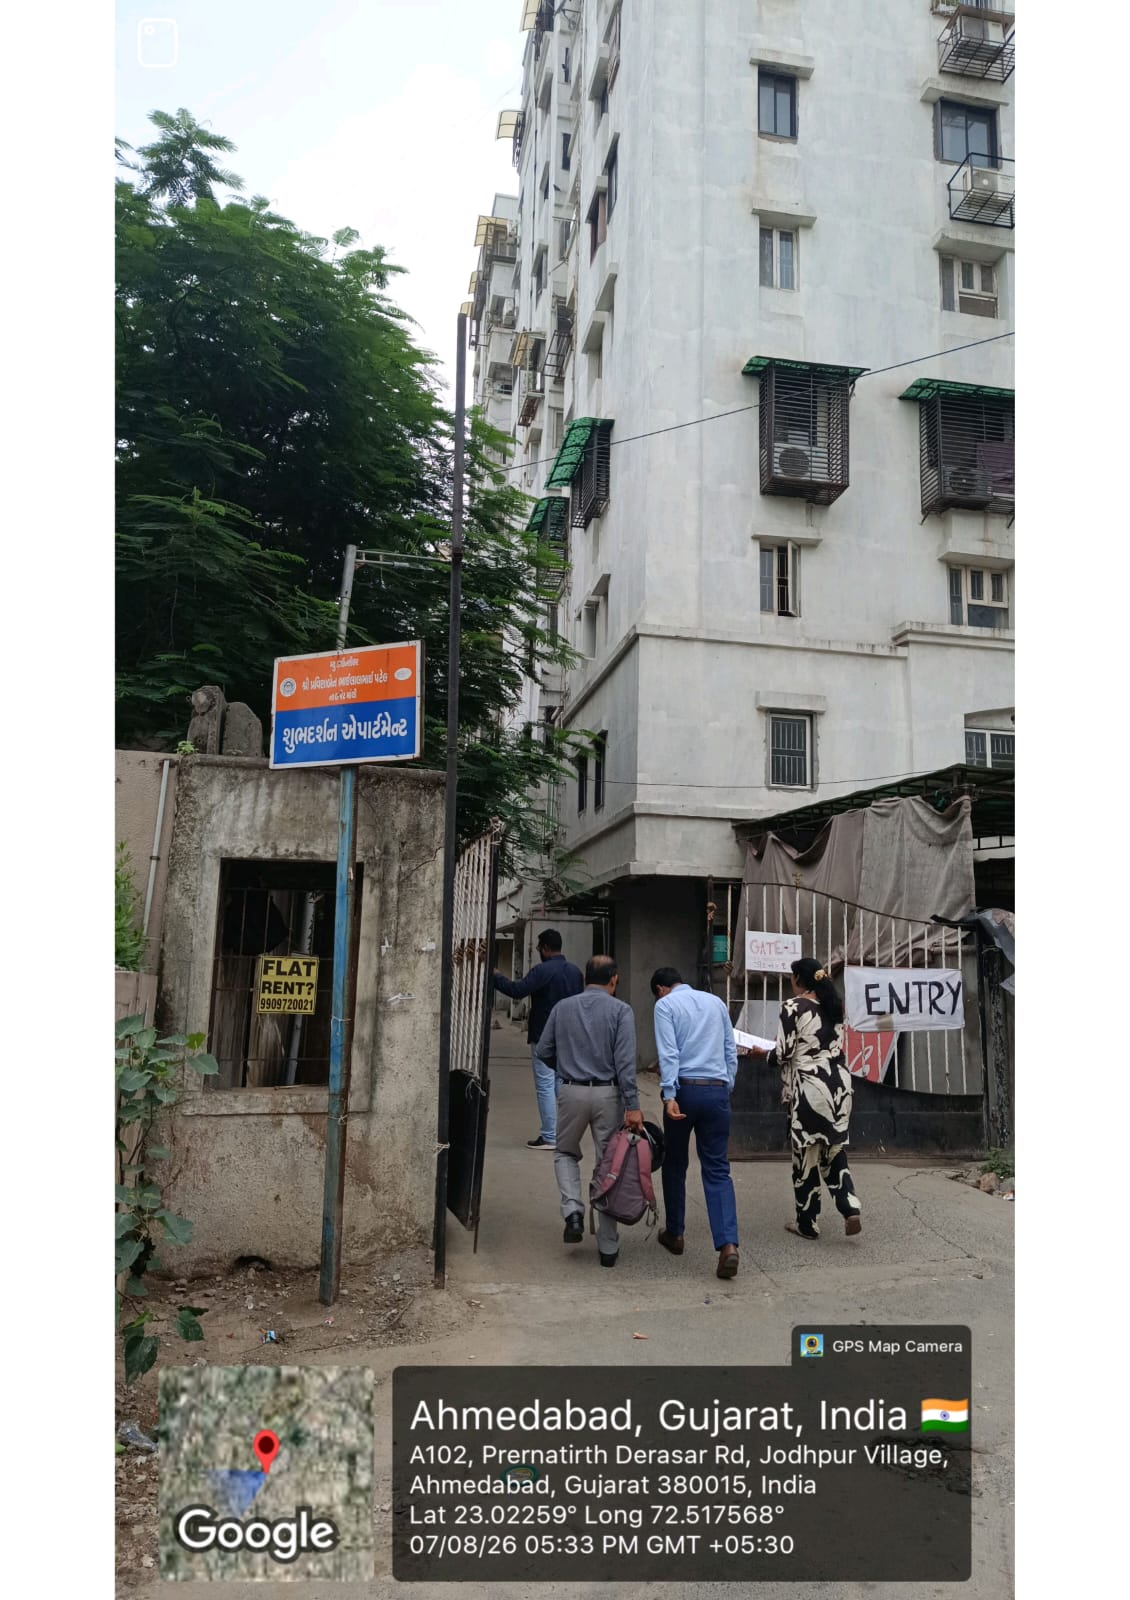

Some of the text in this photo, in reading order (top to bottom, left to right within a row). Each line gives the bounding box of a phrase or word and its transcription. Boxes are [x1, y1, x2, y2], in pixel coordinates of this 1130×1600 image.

[283, 712, 408, 753] શુભદર્શન એપાર્ટમેન્ટ
[262, 959, 316, 977] FLAT
[261, 980, 314, 996] RENT?
[260, 998, 313, 1012] 9909720021
[865, 980, 962, 1016] ENTRY
